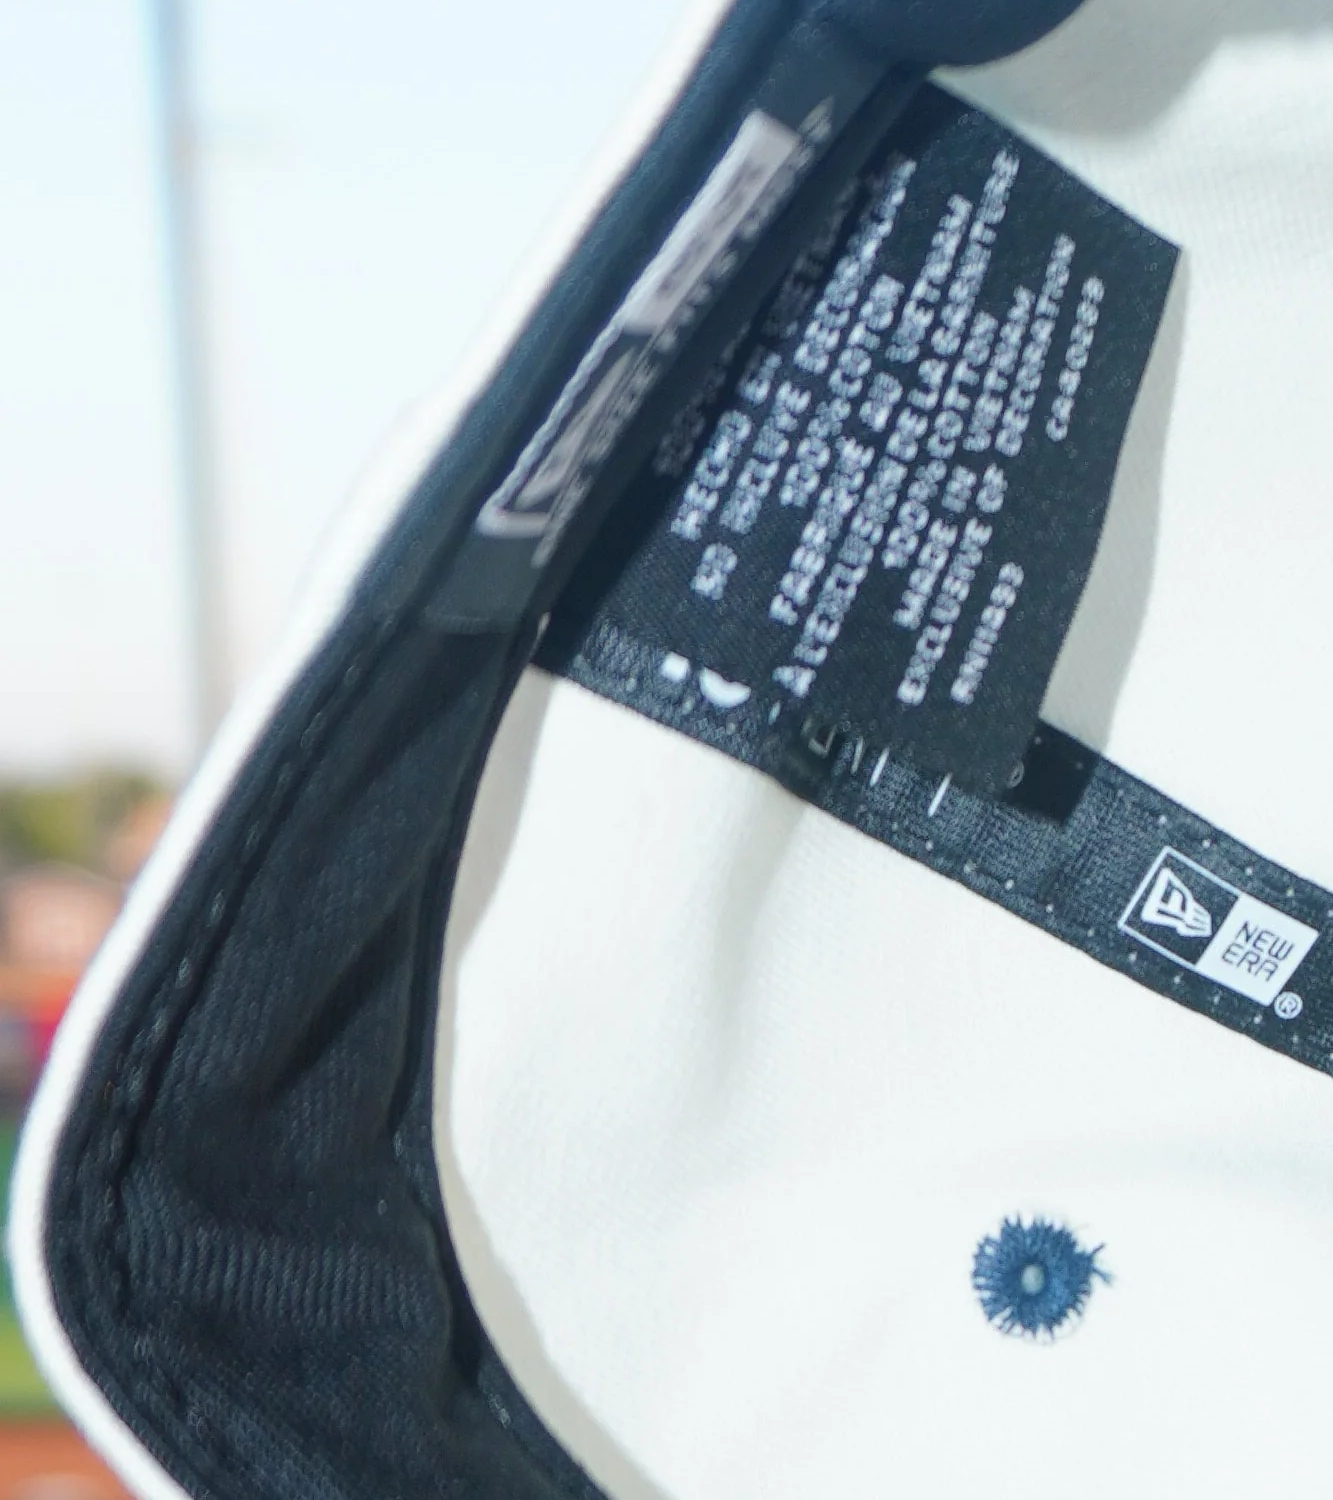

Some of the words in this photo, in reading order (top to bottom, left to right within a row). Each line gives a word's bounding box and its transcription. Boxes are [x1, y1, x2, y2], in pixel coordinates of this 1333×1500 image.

[885, 194, 973, 363] VIETNAM
[907, 358, 949, 410] LA
[930, 149, 1020, 355] GARNITURE
[670, 410, 752, 541] HECHO
[691, 542, 738, 600] NO
[720, 380, 812, 535] INCLUYE
[893, 517, 958, 630] MADE
[941, 465, 977, 513] IN
[962, 285, 1046, 452] VIETNAM
[897, 517, 993, 705] EXCLUSIVE
[976, 463, 1008, 513] OF
[994, 234, 1076, 457] DECORATION
[1221, 942, 1279, 982] ERA
[1234, 920, 1295, 961] NEW
